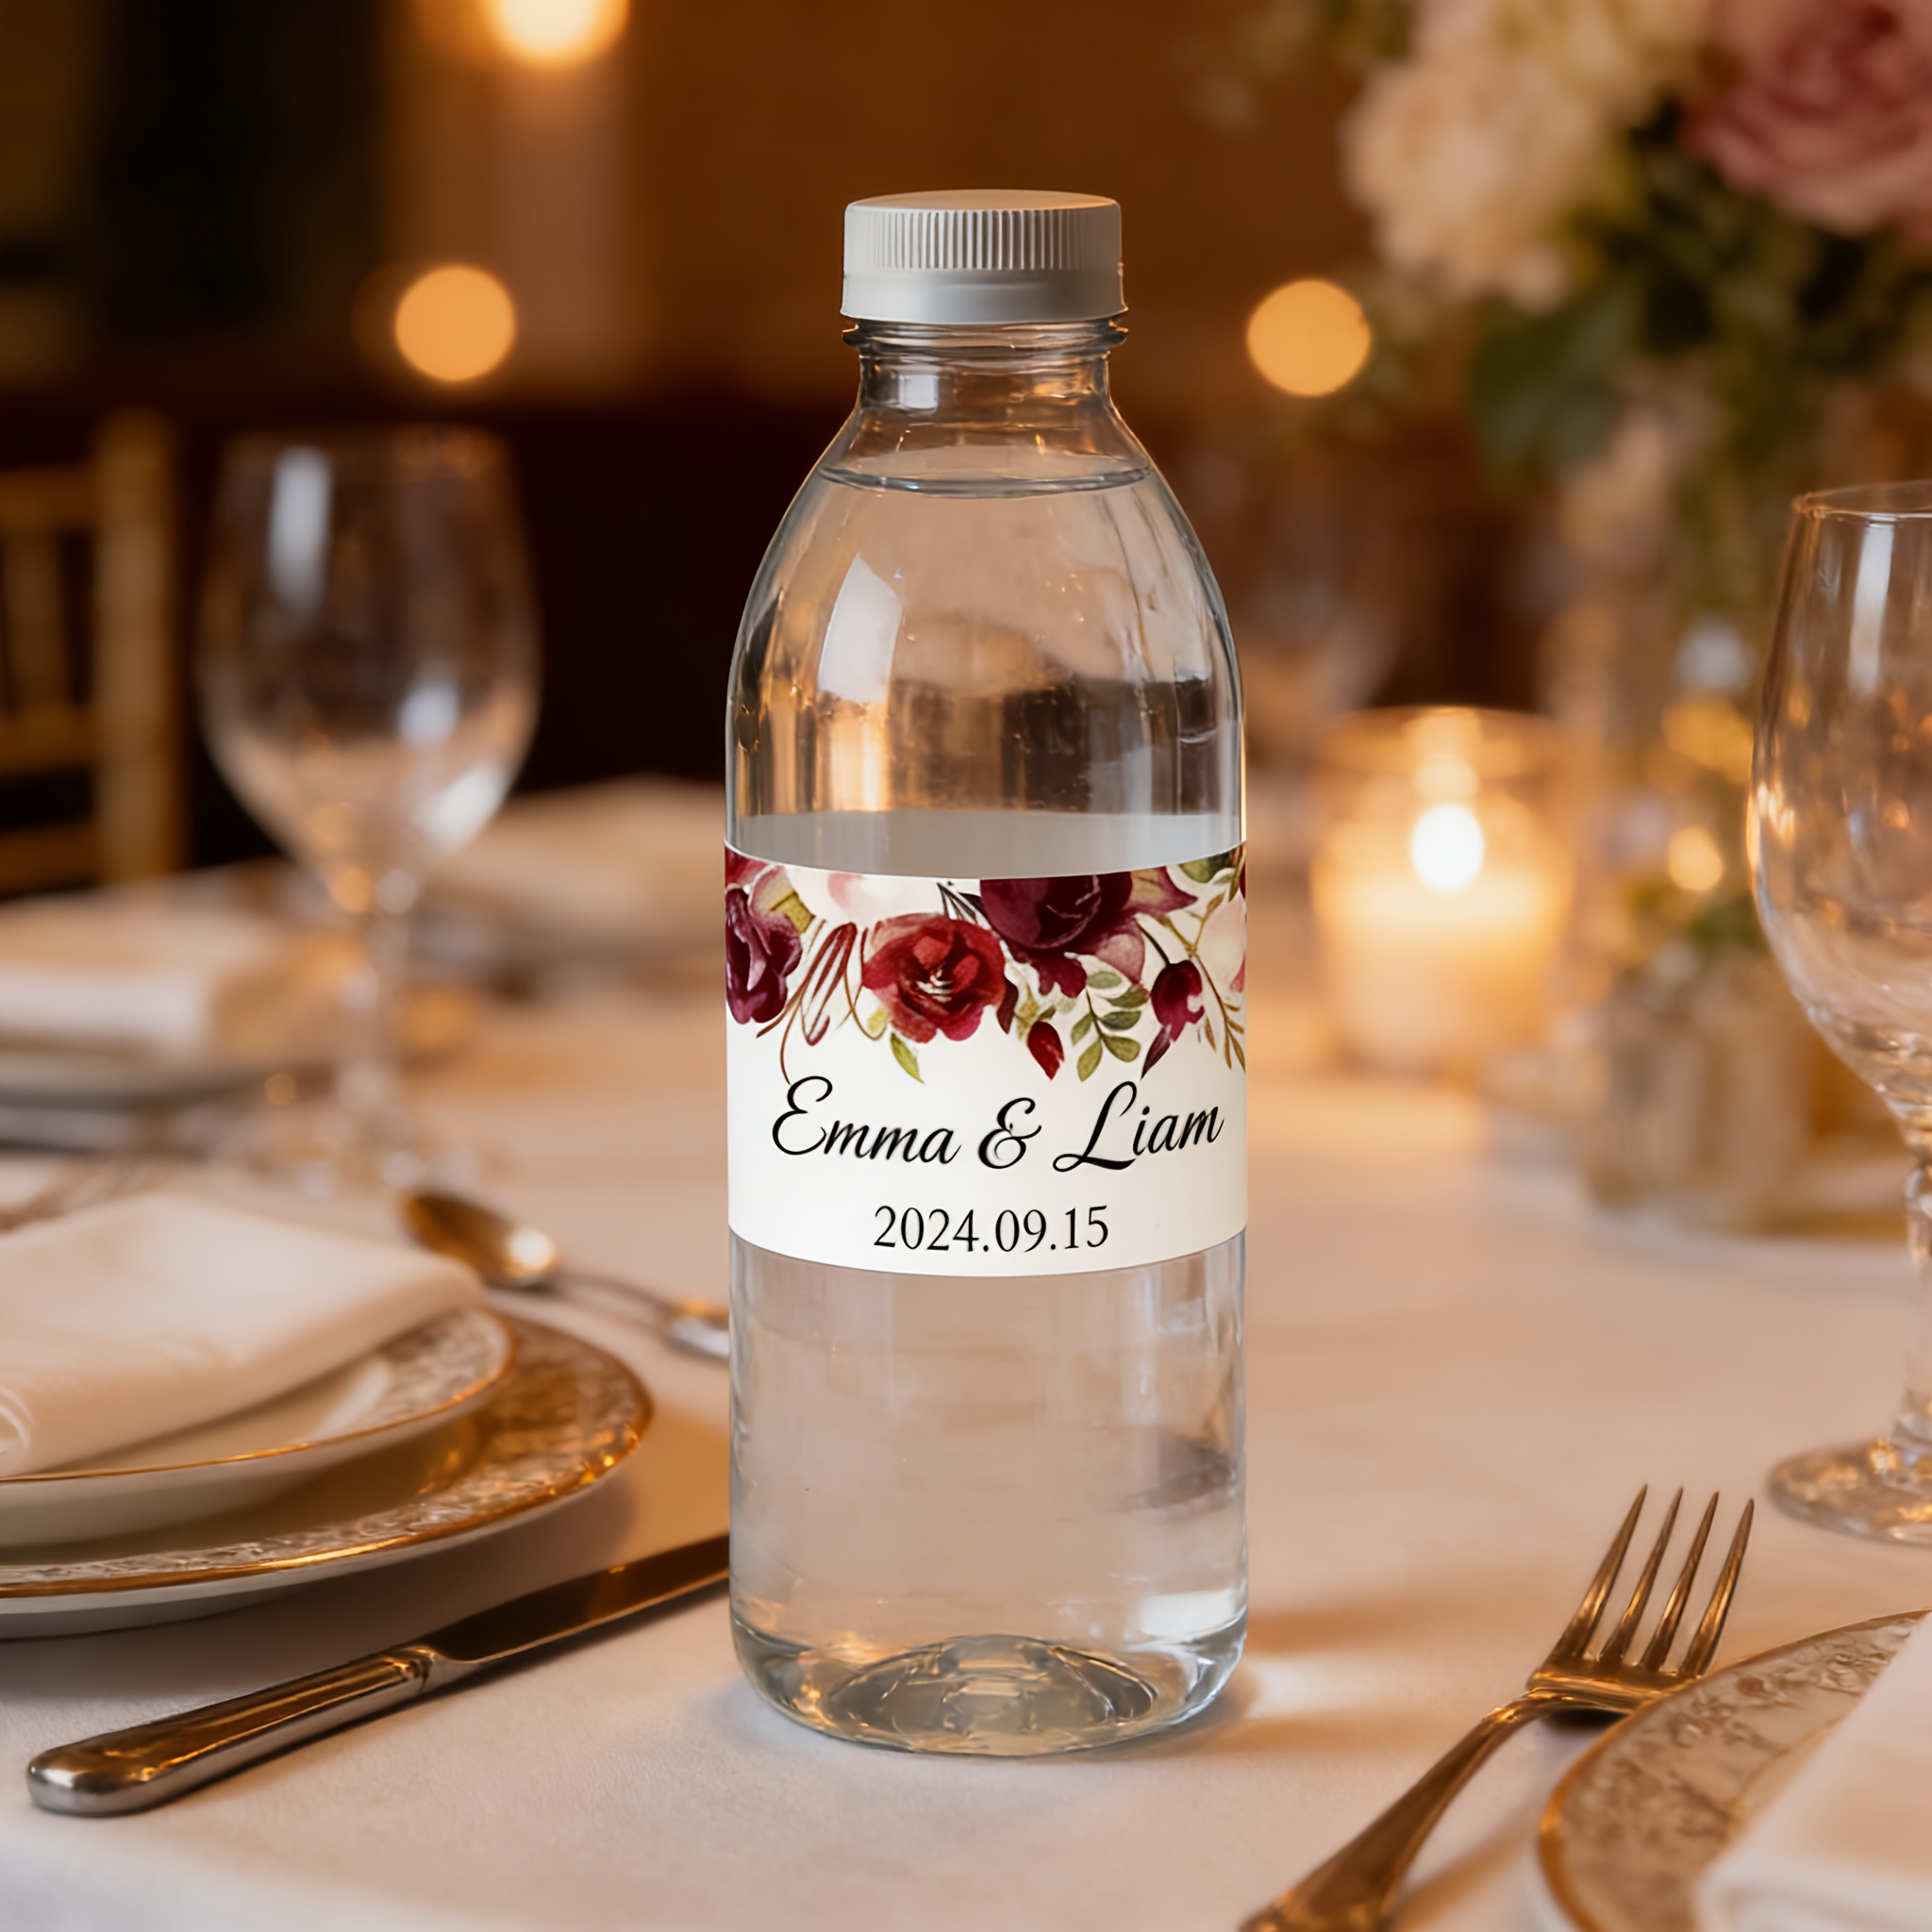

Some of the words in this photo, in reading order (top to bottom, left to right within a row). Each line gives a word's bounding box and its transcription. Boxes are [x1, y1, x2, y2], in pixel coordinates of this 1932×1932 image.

[772, 1075, 962, 1165] Emma
[977, 1096, 1042, 1170] &
[1052, 1080, 1225, 1173] Liam
[874, 1205, 1108, 1253] 2024.09.15
